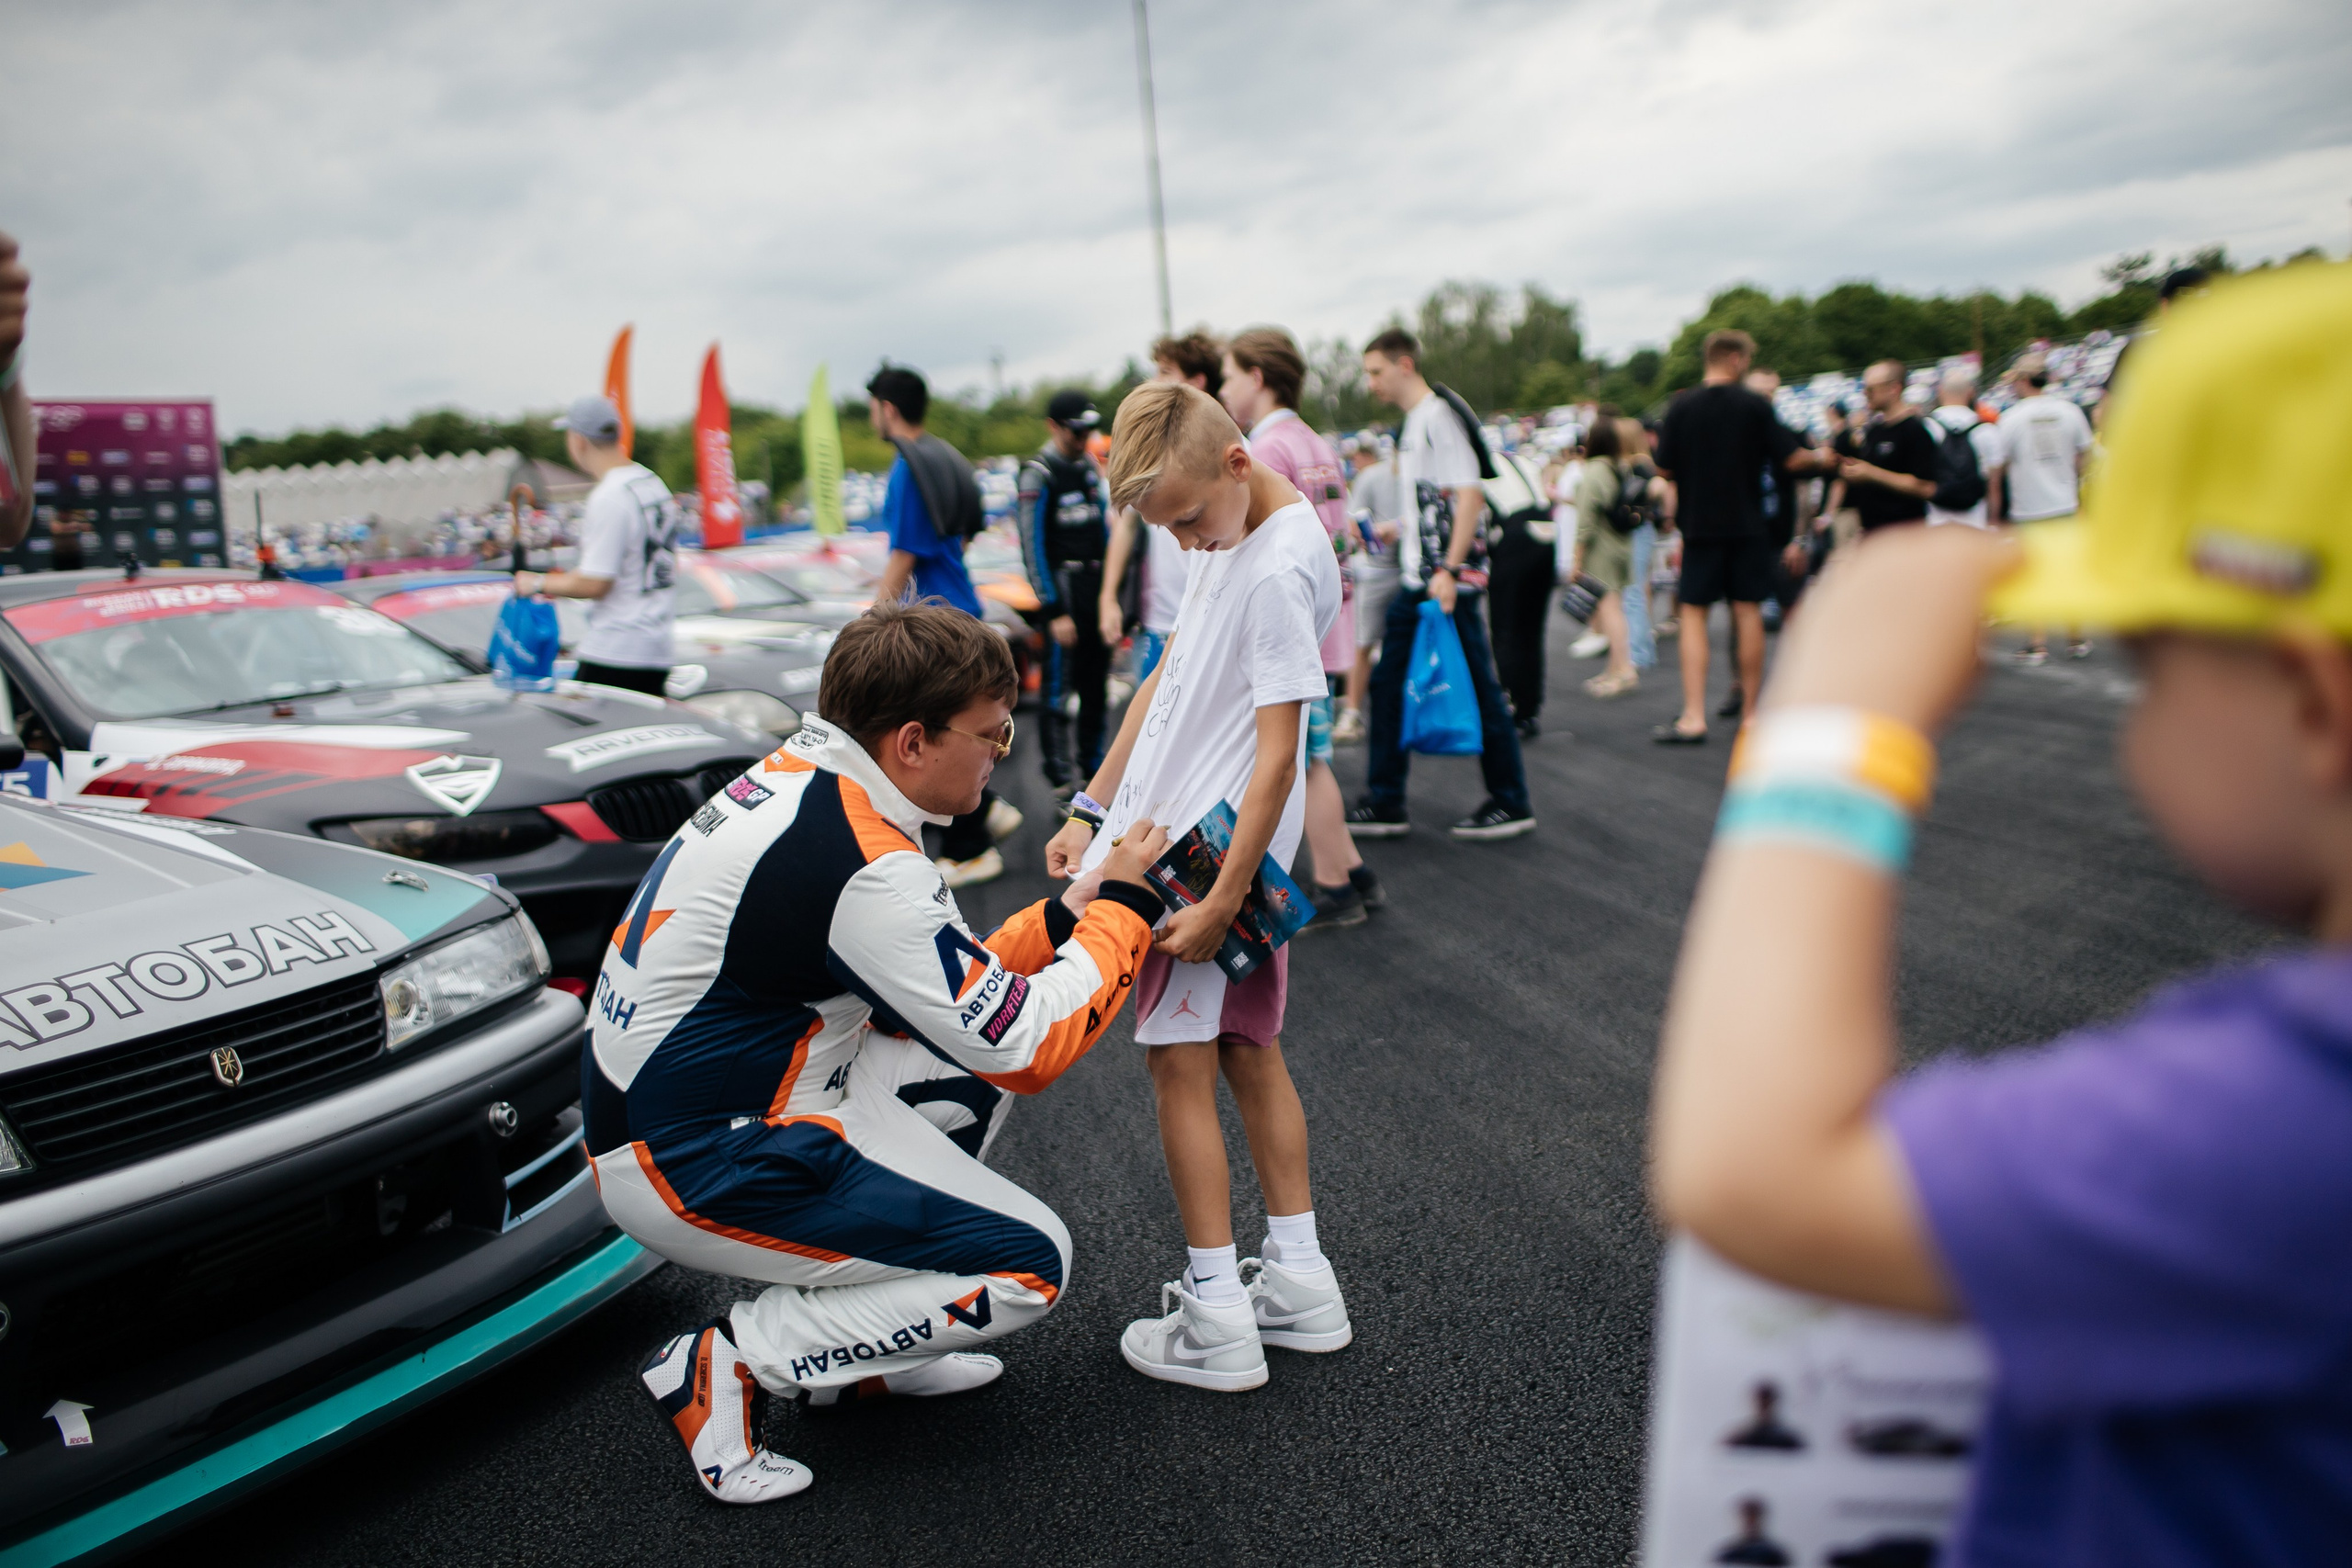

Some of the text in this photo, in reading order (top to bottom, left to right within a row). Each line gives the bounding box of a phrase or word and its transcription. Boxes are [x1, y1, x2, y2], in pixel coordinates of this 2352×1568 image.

[150, 583, 246, 609] RDS
[791, 1317, 933, 1382] АВТОБАН
[69, 1436, 90, 1445] RDS
